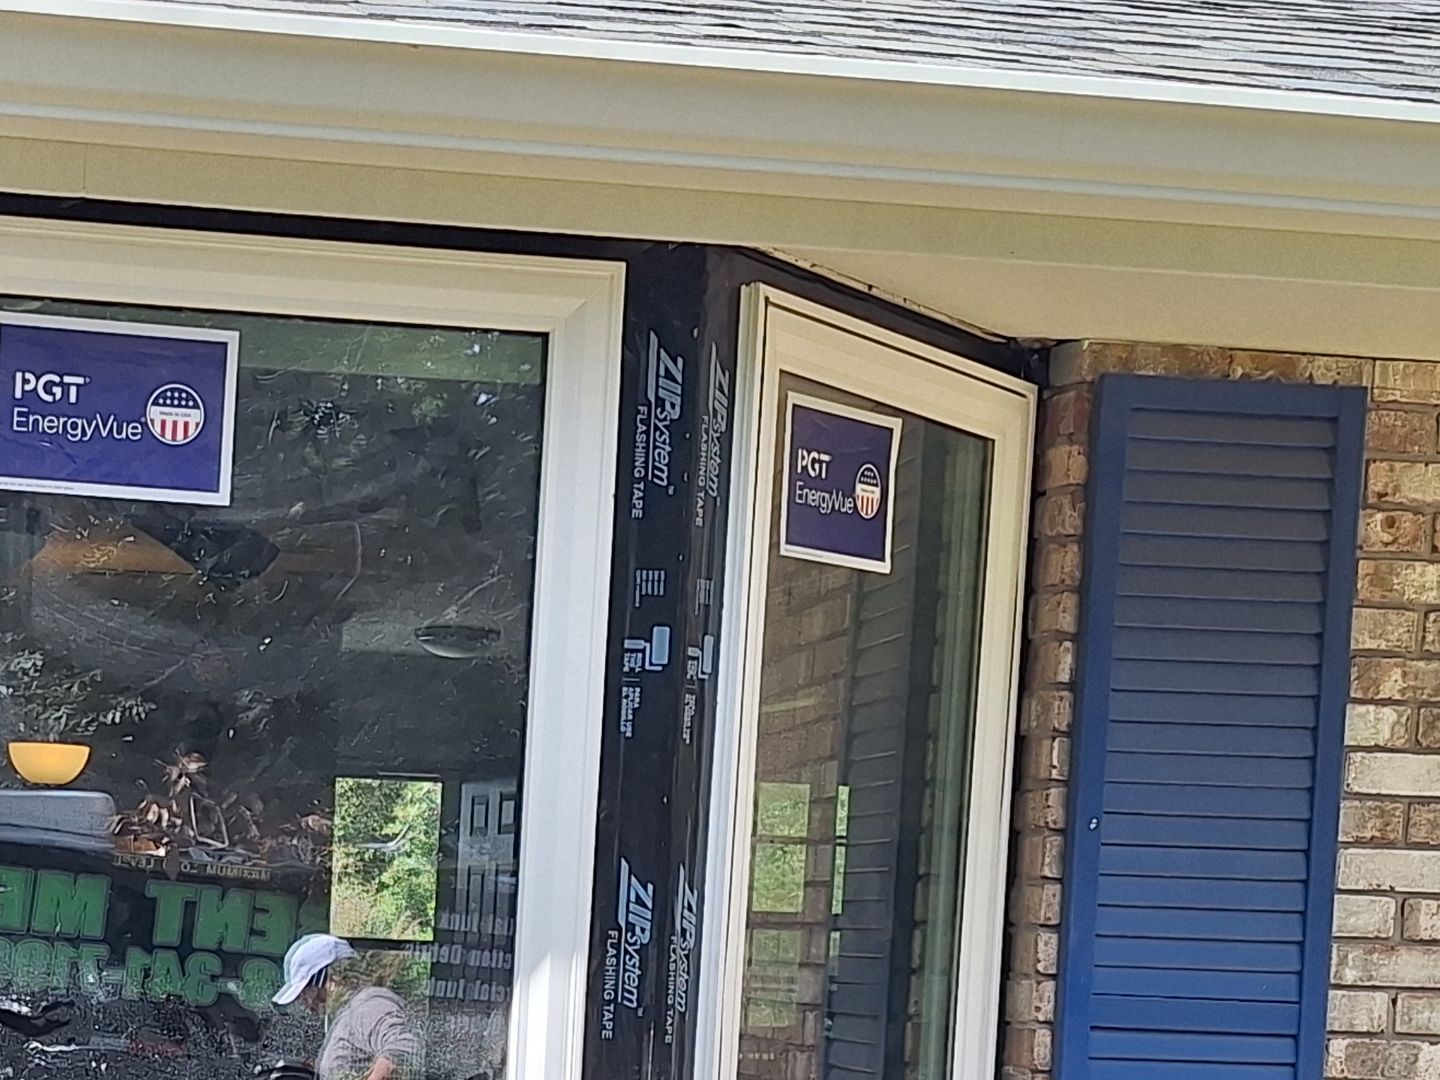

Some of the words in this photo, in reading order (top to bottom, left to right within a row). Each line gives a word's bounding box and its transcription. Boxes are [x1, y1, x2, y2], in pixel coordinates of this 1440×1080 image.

[14, 371, 85, 404] PGT
[12, 407, 143, 442] EnergyVue
[634, 405, 648, 478] FLASHING
[697, 415, 708, 488] FLASHING
[796, 448, 832, 480] PGT
[631, 481, 645, 519] TAPE
[695, 491, 705, 527] TAPE
[795, 481, 854, 514] EnergyVue
[604, 930, 619, 1000] FLASHING
[601, 1003, 615, 1040] TAPE
